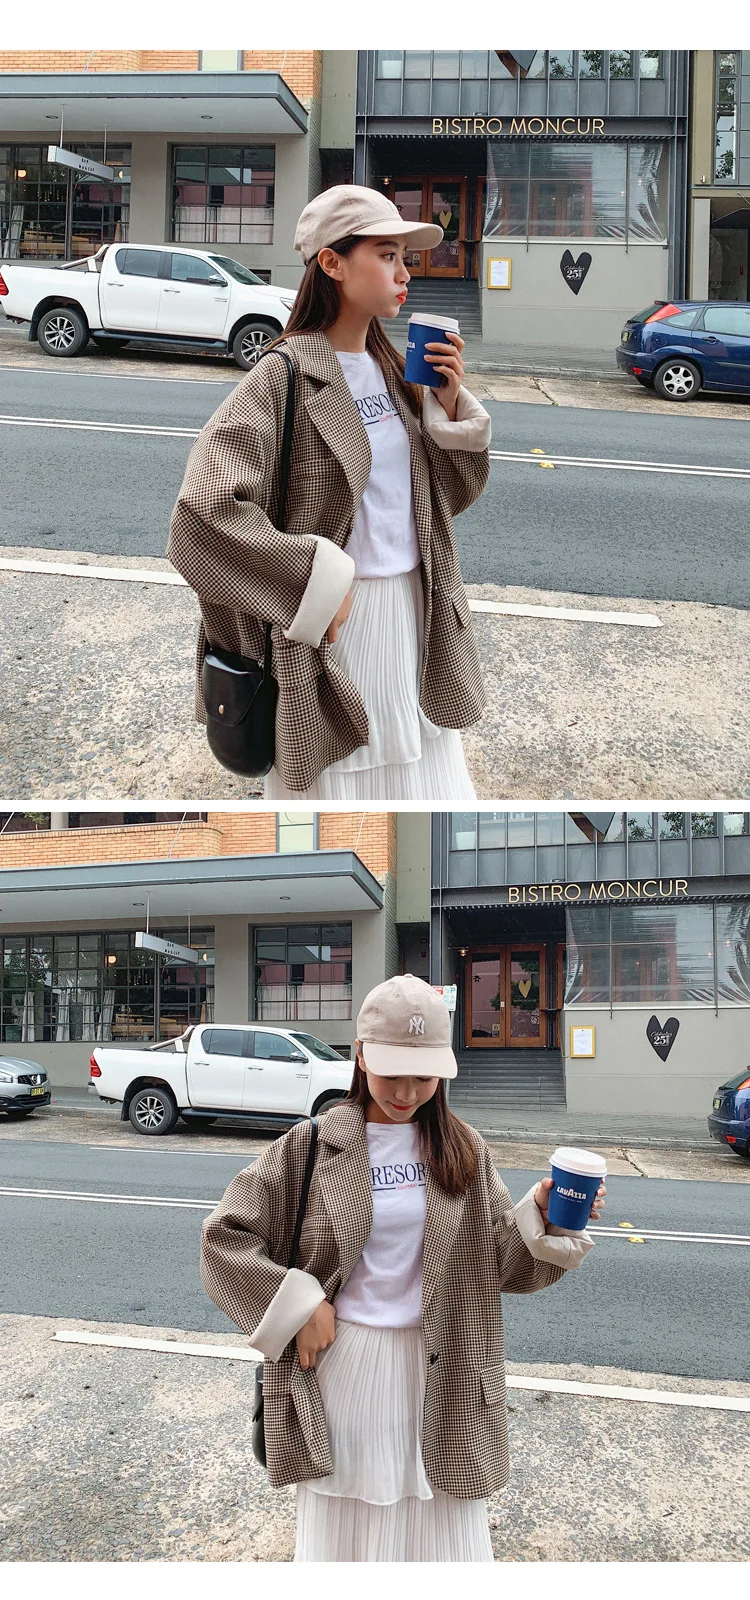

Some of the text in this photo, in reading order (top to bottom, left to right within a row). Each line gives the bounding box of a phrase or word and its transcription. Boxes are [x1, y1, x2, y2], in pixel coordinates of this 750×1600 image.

[432, 118, 605, 135] BISTRO MONCUR
[508, 879, 688, 903] BISTRO MONCUR
[408, 1015, 425, 1035] NY
[556, 1186, 587, 1200] LAVAZZA
